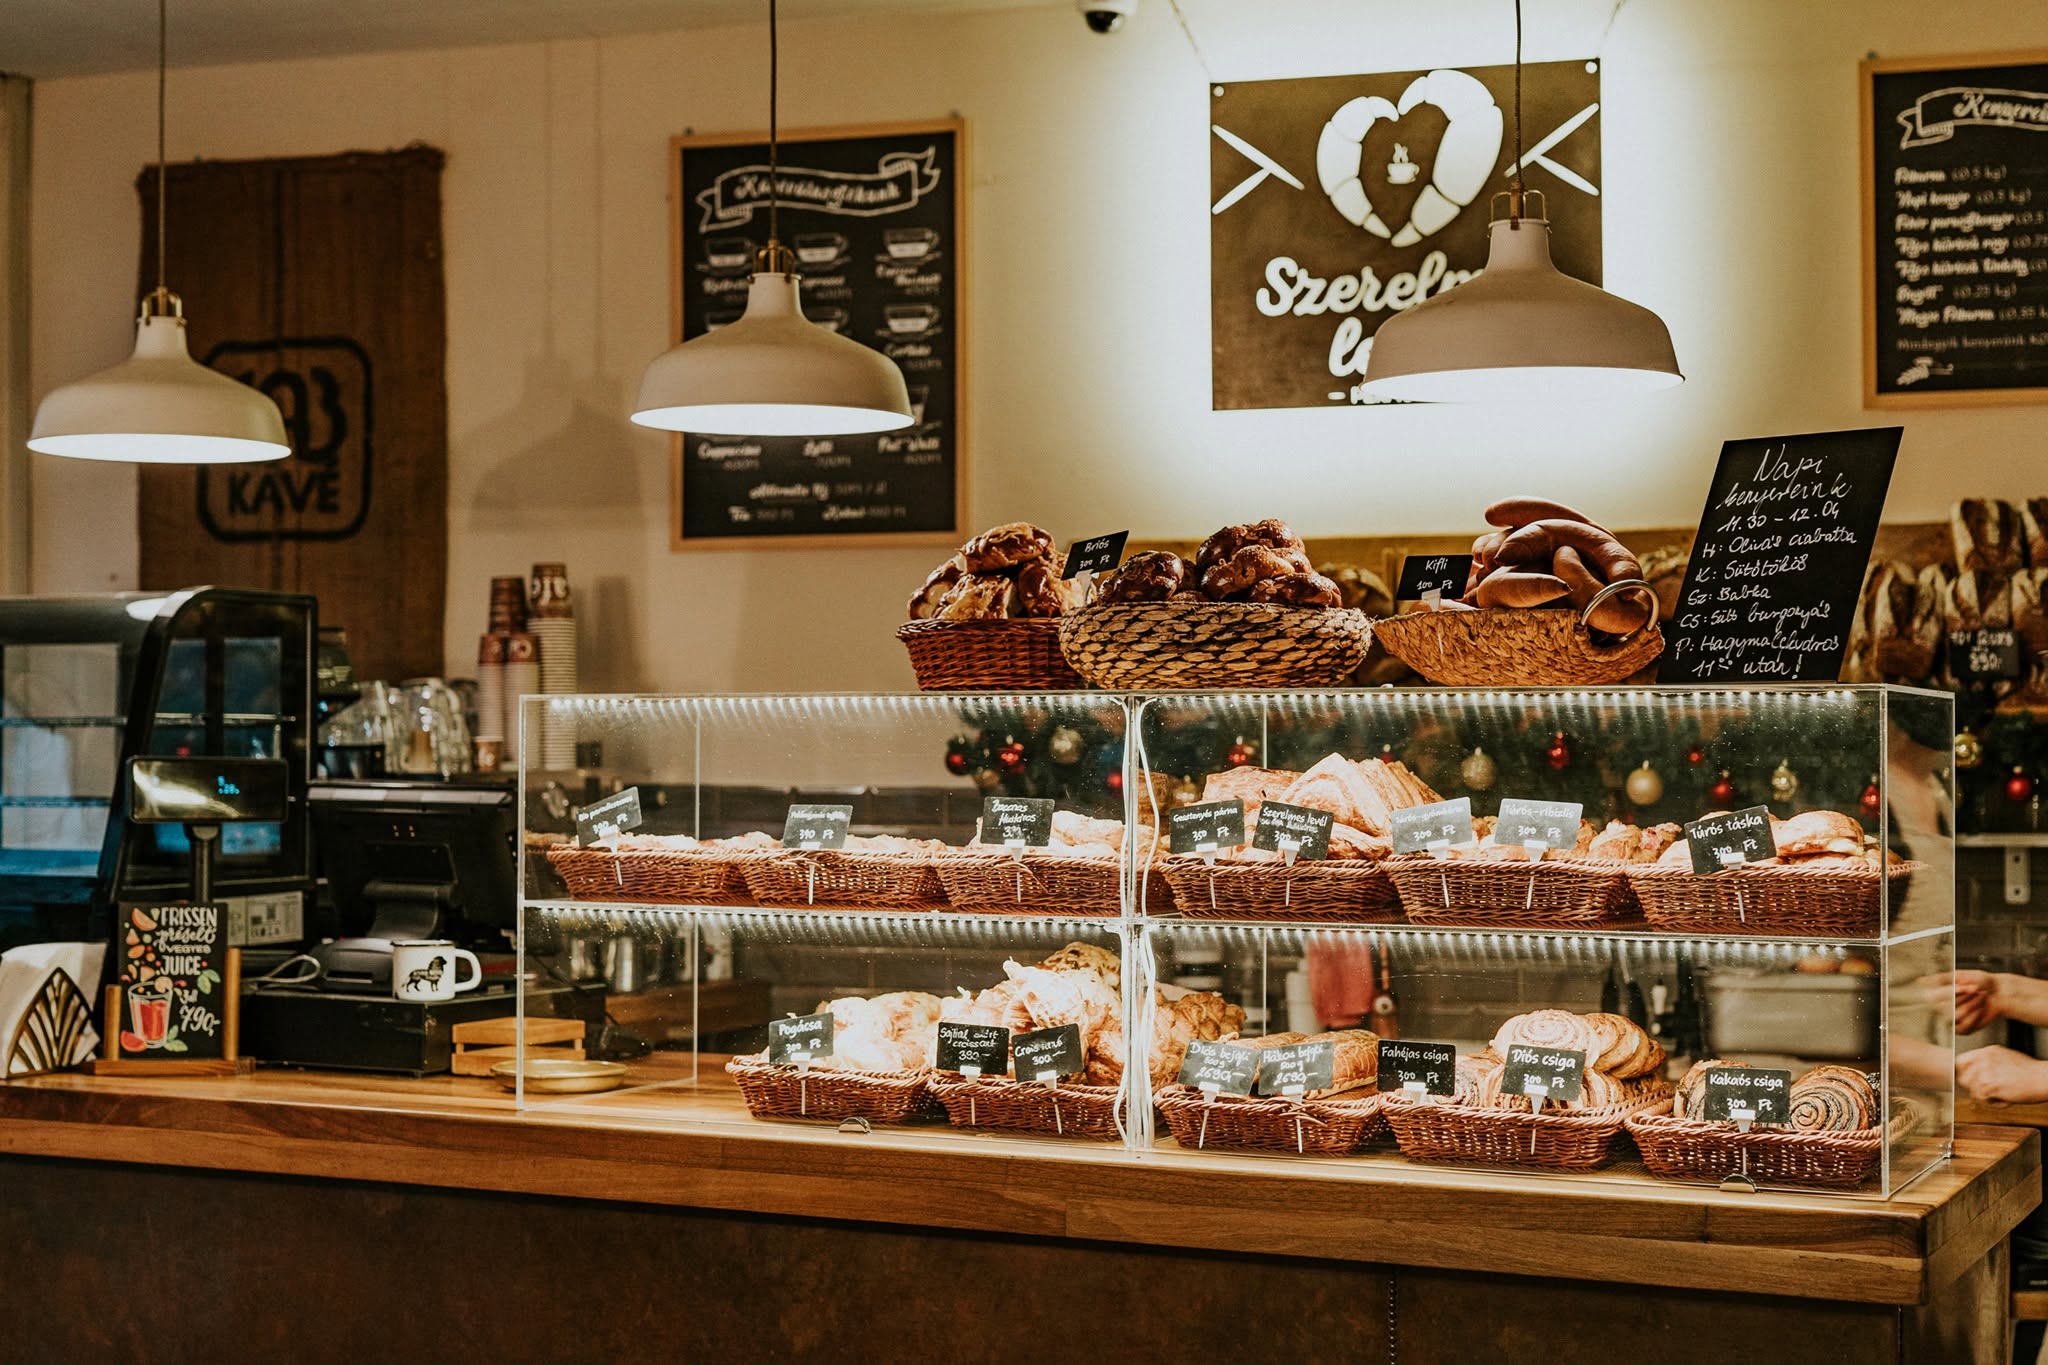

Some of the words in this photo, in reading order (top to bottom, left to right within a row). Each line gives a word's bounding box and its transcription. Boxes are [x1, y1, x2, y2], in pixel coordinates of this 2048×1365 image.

[1753, 444, 1828, 492] Napi
[1788, 525, 1857, 547] ciabatta
[1425, 557, 1449, 574] Kifli
[1416, 580, 1433, 590] 100
[1441, 579, 1453, 590] Ft
[1717, 585, 1772, 601] Babka
[1263, 806, 1306, 823] Szerelmes
[1217, 826, 1230, 838] Ft
[1412, 829, 1432, 841] 300
[1441, 824, 1456, 836] Ft
[1517, 825, 1537, 836] 300
[1547, 826, 1562, 838] Ft
[1689, 822, 1723, 840] Túrós
[1725, 813, 1763, 831] táska
[1300, 835, 1314, 847] Ft
[1712, 845, 1733, 859] 300
[1742, 838, 1758, 852] Ft
[161, 906, 218, 928] FRISSEN
[160, 955, 202, 976] JUICE
[779, 1020, 823, 1039] Pogácsa
[809, 1038, 821, 1049] Ft
[1381, 1046, 1420, 1063] Fahéjas
[1422, 1047, 1450, 1065] csiga
[1511, 1048, 1539, 1064] Diós
[1541, 1053, 1576, 1072] csiga
[1398, 1070, 1416, 1081] 300
[1426, 1071, 1440, 1084] Ft
[1523, 1073, 1542, 1084] 300
[1551, 1076, 1566, 1088] Ft
[1709, 1072, 1751, 1086] Kakaós
[1753, 1075, 1783, 1091] csiga
[1726, 1097, 1747, 1110] 300
[1757, 1098, 1773, 1111] Ft
